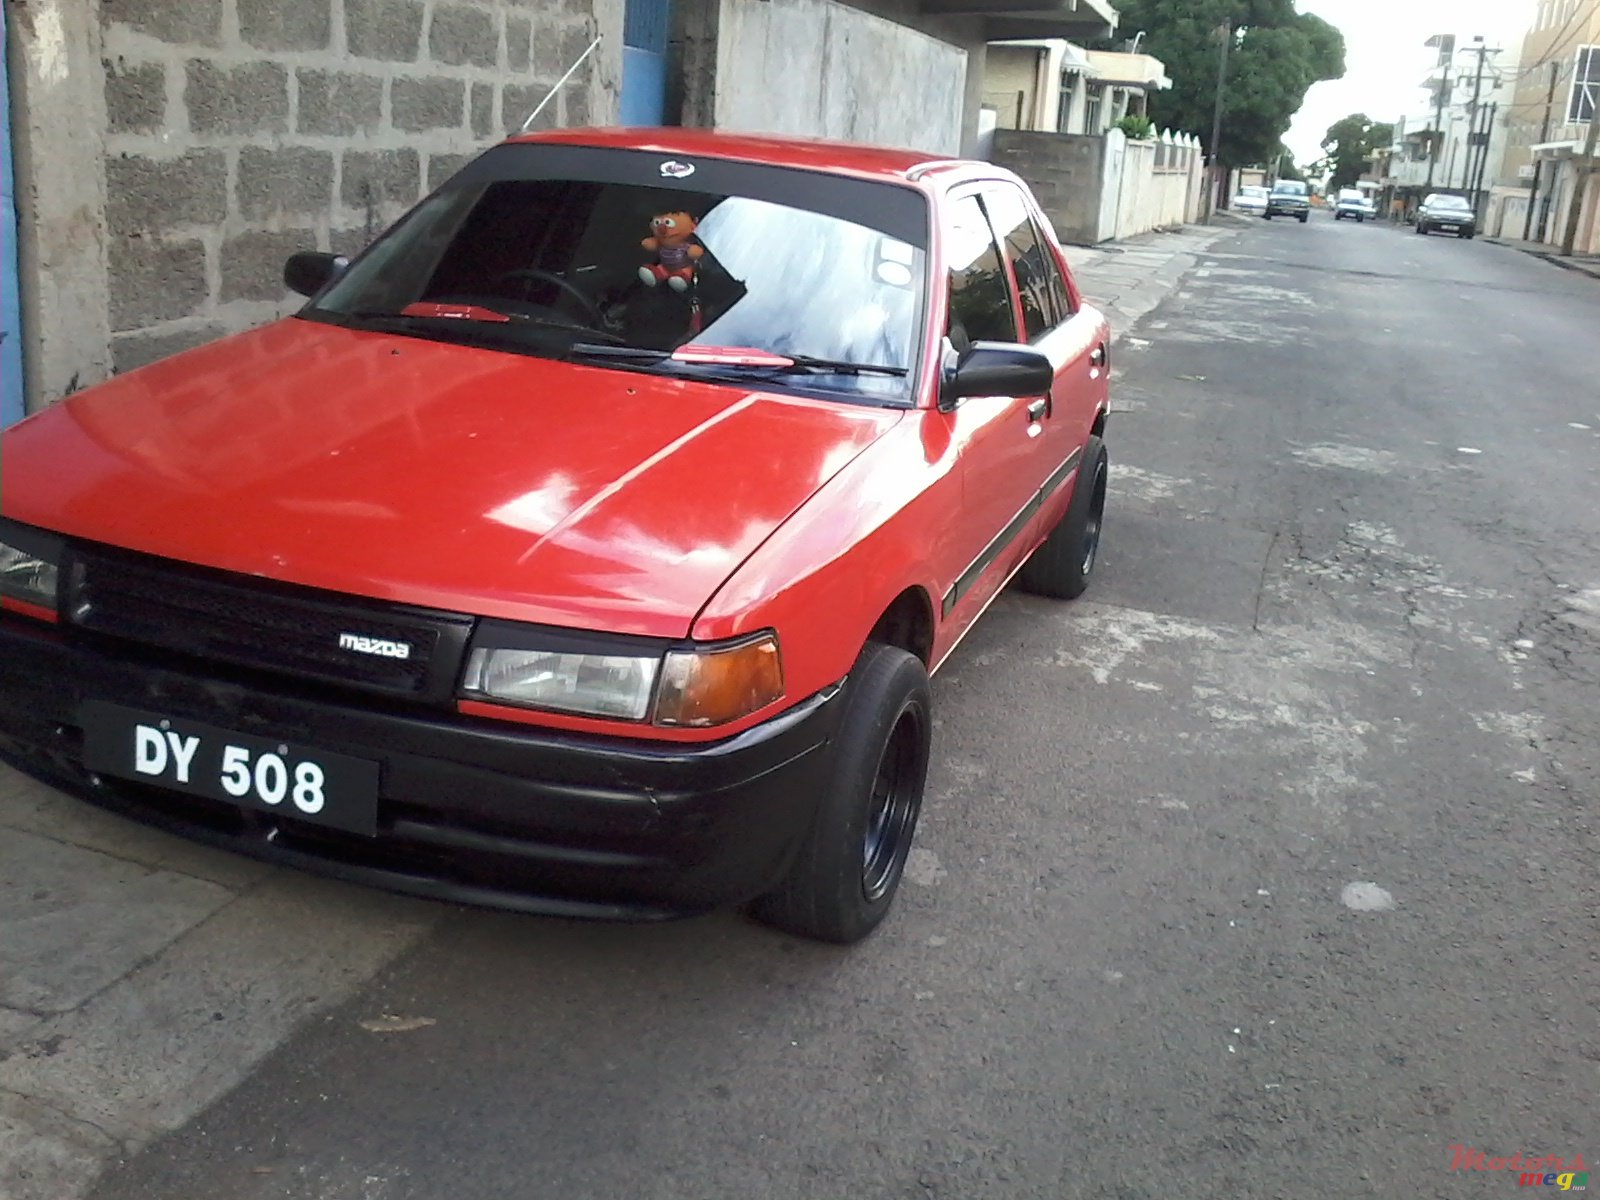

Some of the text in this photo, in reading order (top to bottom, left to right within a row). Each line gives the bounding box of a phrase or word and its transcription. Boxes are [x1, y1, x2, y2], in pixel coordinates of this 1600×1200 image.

[339, 633, 409, 659] mazda
[135, 724, 325, 815] DY 508
